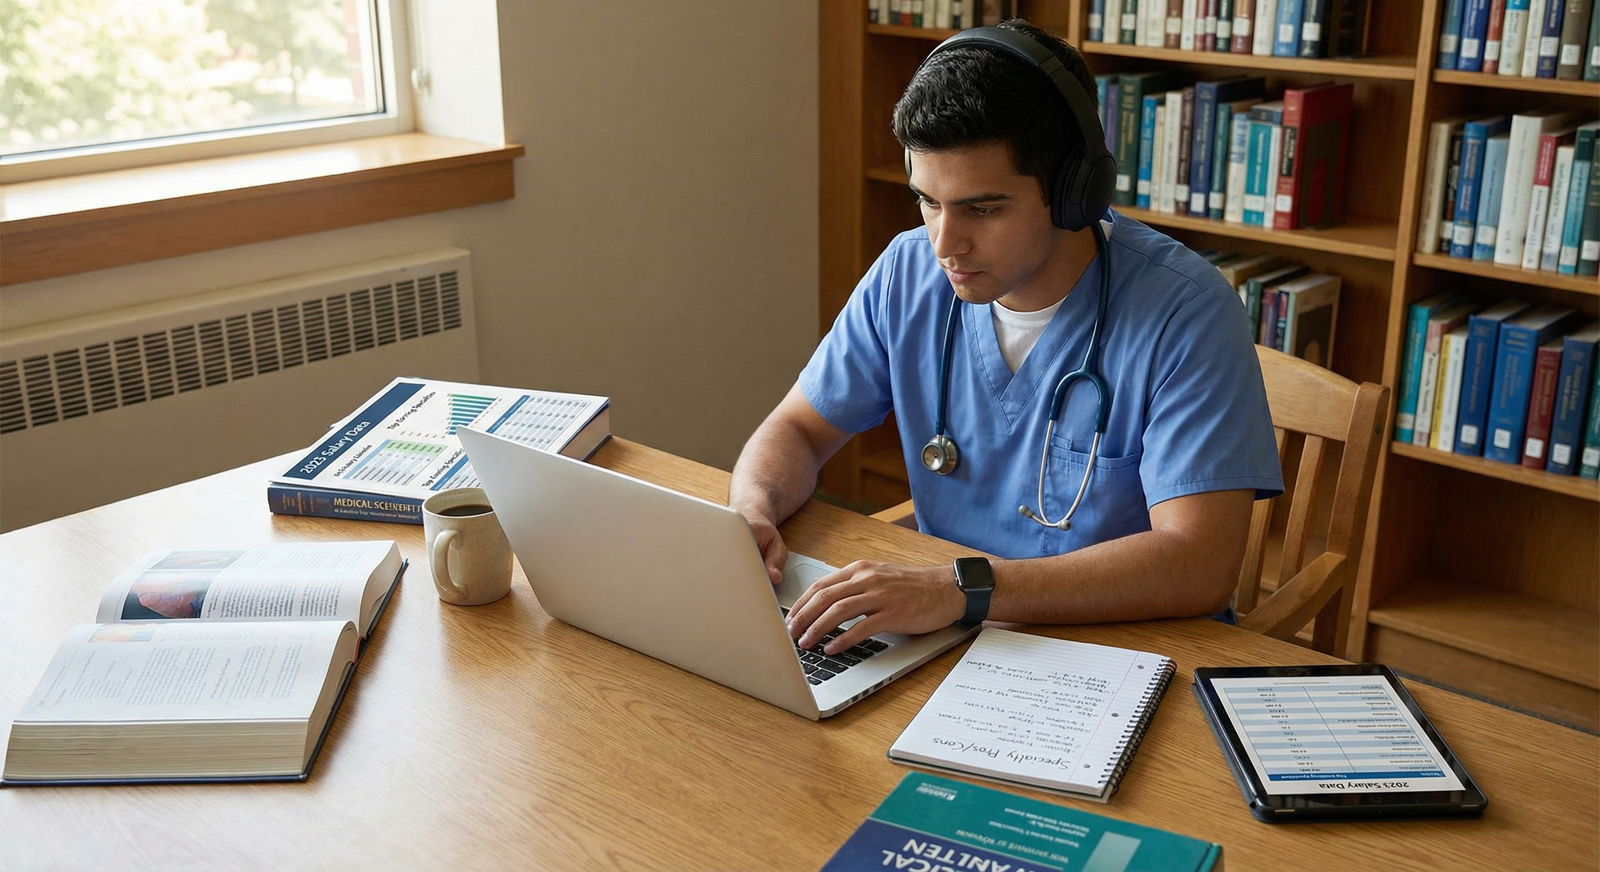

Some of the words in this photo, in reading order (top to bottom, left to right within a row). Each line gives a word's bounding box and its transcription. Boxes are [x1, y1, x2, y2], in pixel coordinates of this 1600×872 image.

[300, 456, 327, 474] 2023
[321, 435, 354, 457] Salary
[346, 421, 371, 437] Data
[333, 497, 373, 510] MEDICAL
[932, 737, 1000, 759] Pros/Cons
[1007, 750, 1073, 771] Specialty
[1348, 782, 1382, 790] Salary
[1383, 781, 1410, 789] 2023
